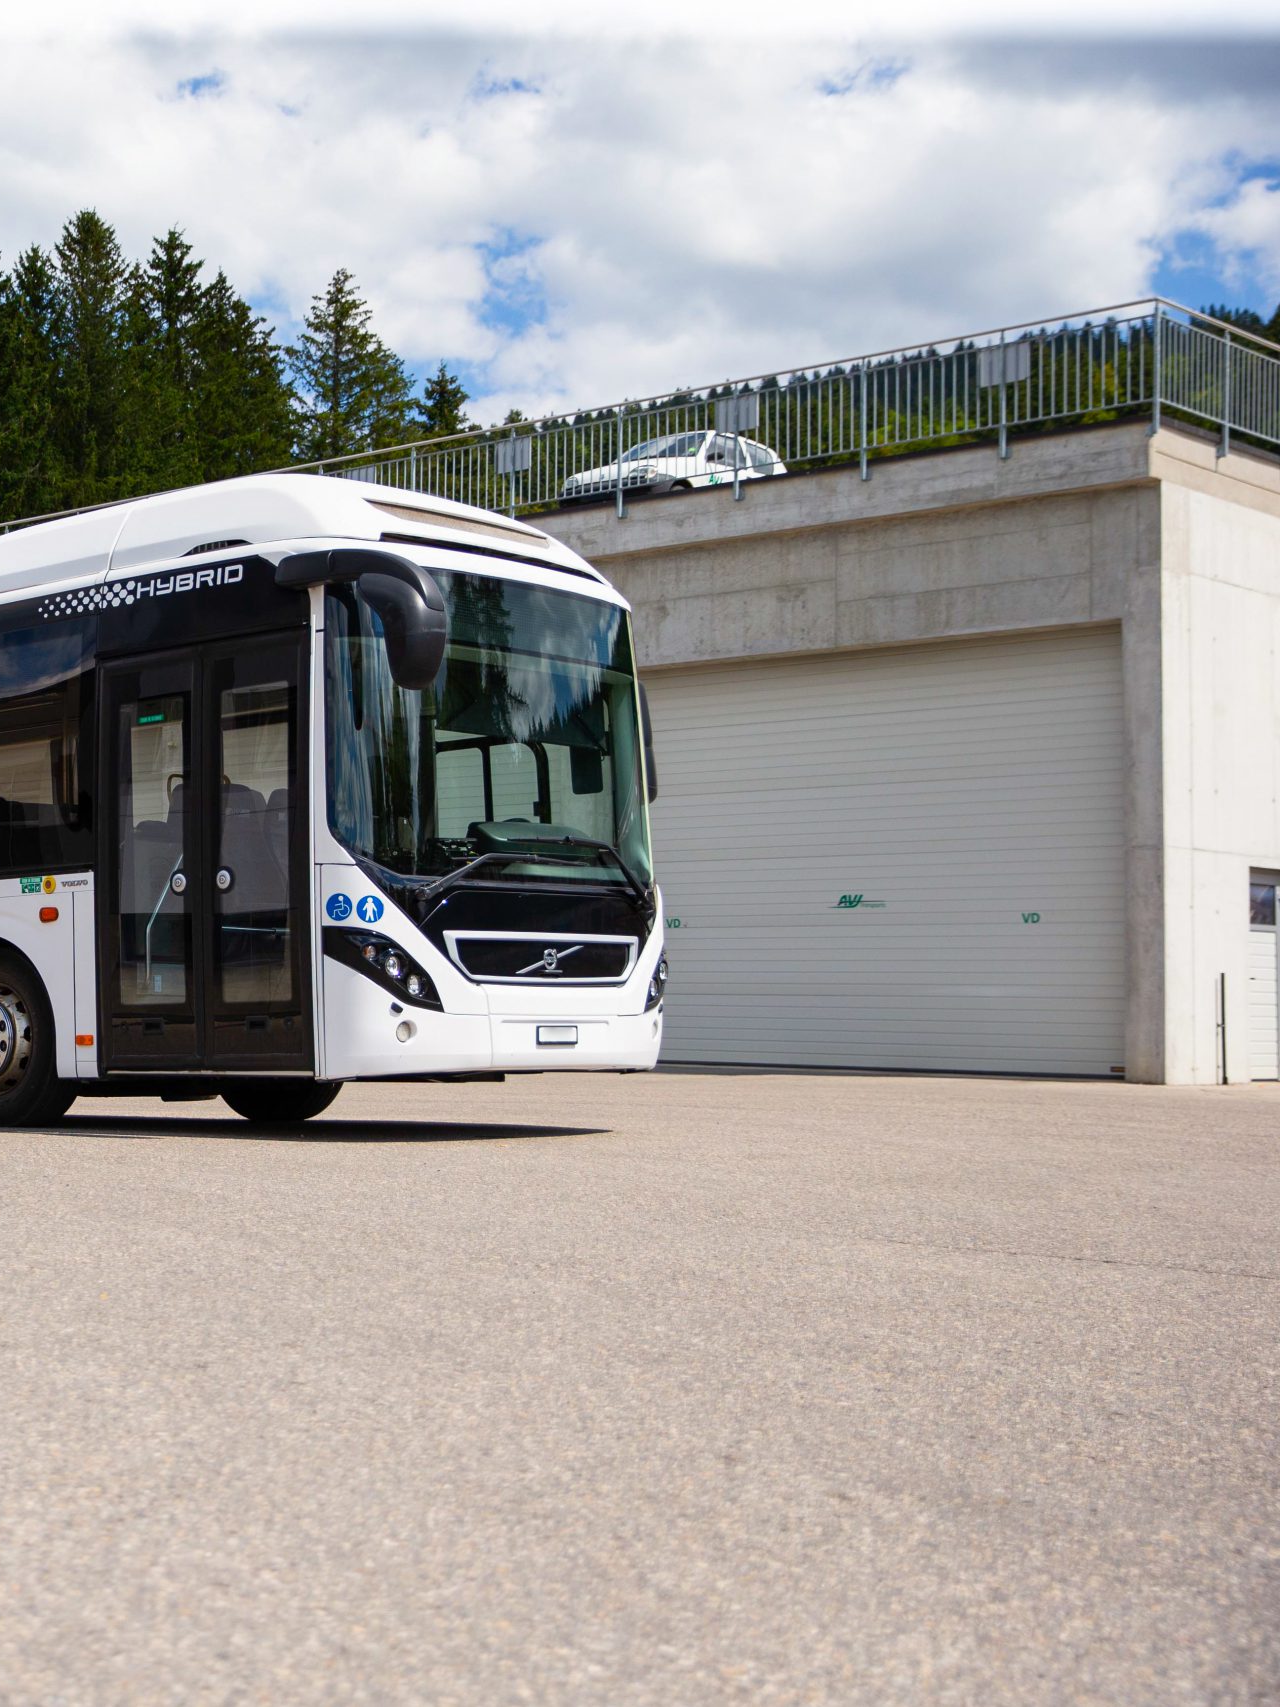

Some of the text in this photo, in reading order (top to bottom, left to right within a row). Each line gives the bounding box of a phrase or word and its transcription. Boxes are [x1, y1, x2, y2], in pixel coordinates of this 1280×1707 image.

[136, 564, 243, 599] HYBRID
[61, 879, 88, 887] VOLVO
[1021, 912, 1040, 924] VD
[666, 919, 681, 928] VD
